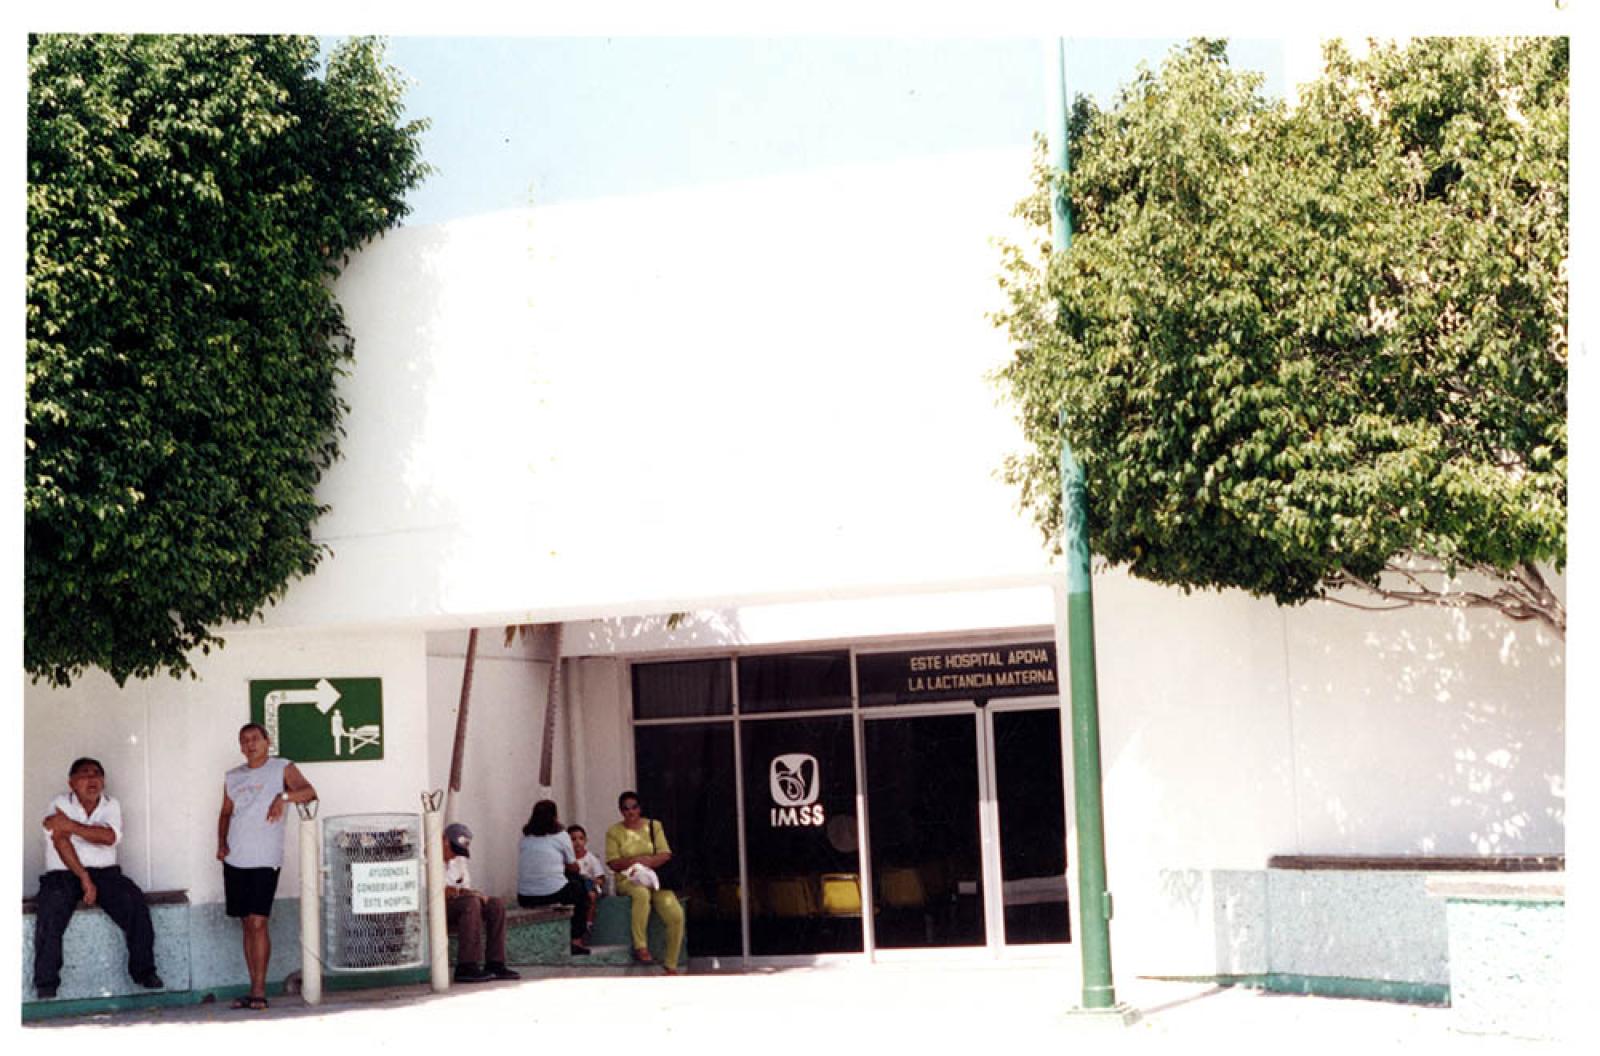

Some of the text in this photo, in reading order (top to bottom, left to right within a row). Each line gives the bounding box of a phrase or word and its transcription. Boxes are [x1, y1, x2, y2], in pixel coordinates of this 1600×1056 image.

[910, 648, 1049, 671] ESTE HOSPITAL APOYA
[909, 669, 1055, 691] LA LACTANCIA MATERNA
[770, 804, 825, 827] IMSS
